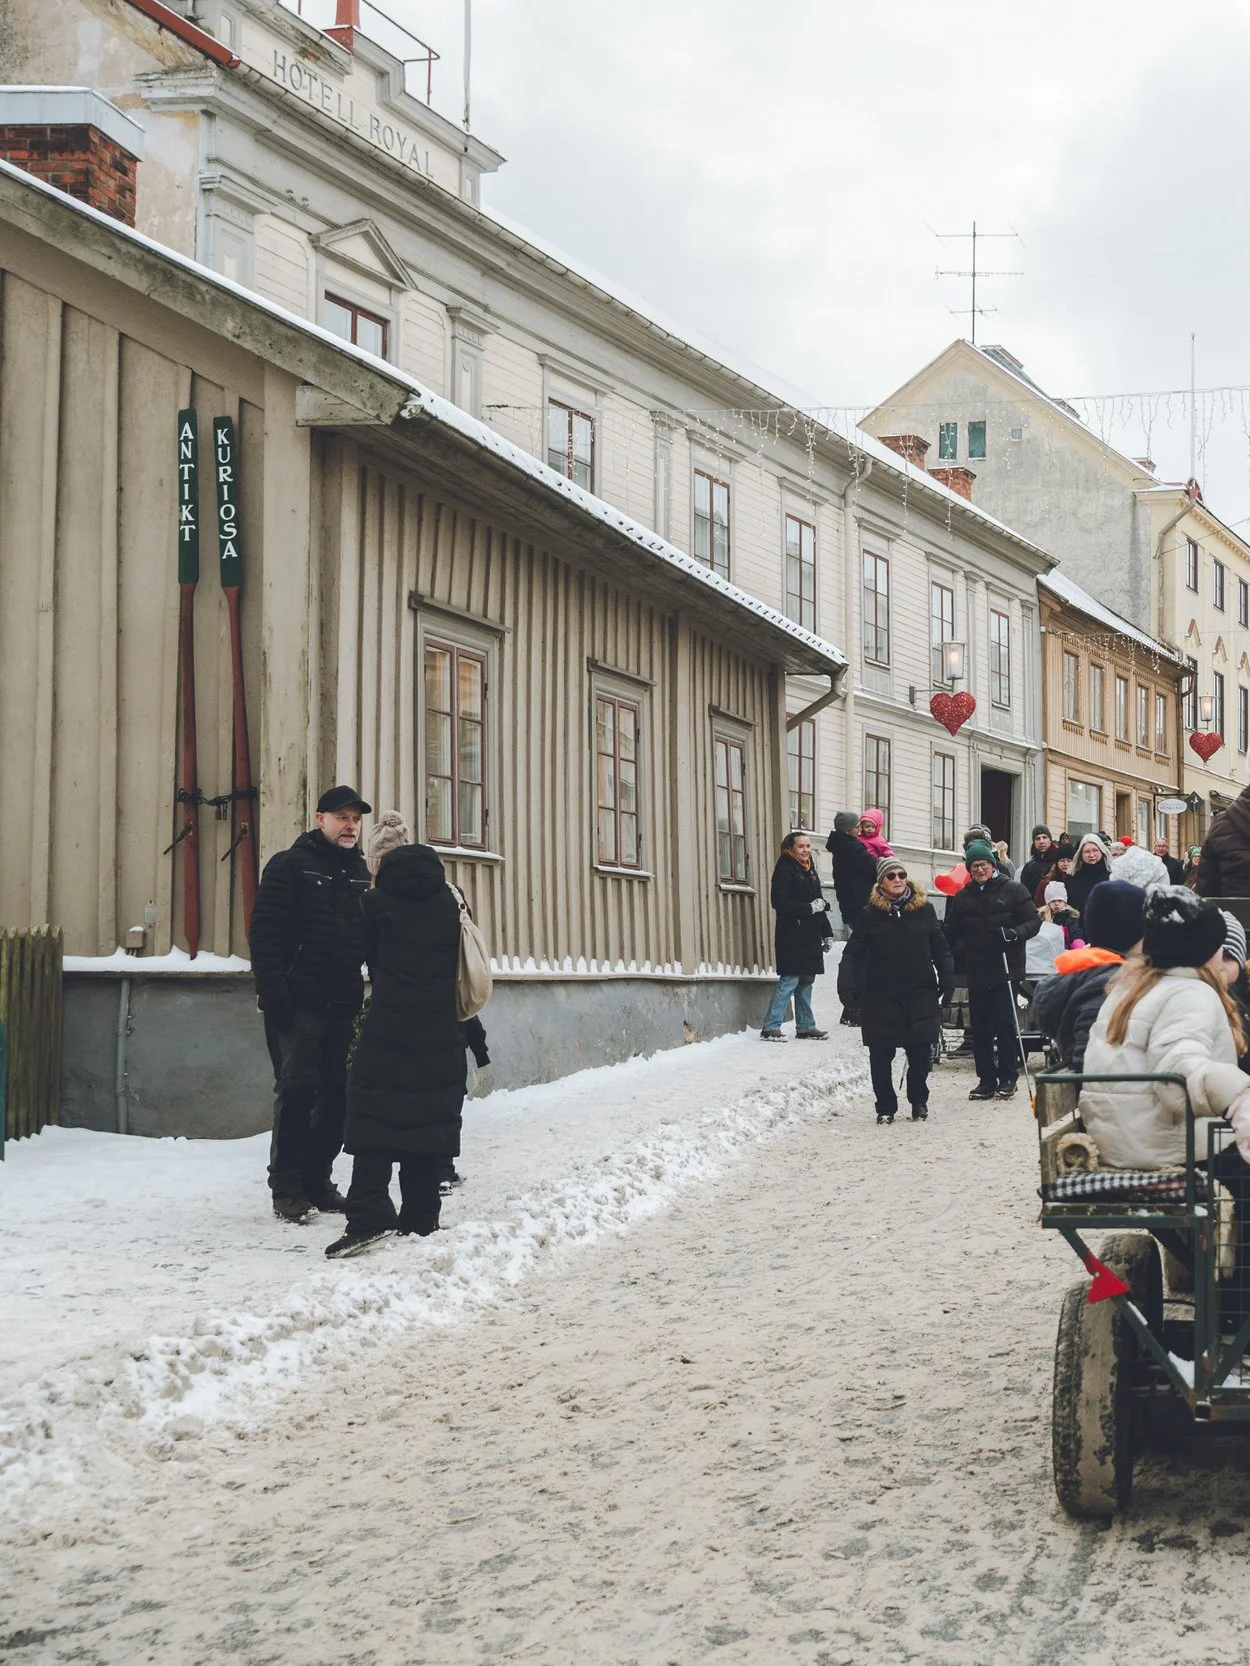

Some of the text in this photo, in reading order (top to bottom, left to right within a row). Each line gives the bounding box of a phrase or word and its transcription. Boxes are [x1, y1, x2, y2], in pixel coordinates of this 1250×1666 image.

[273, 49, 435, 179] HOTELL ROYAL
[179, 421, 196, 541] ANTIKT
[216, 428, 238, 559] KURIOSA
